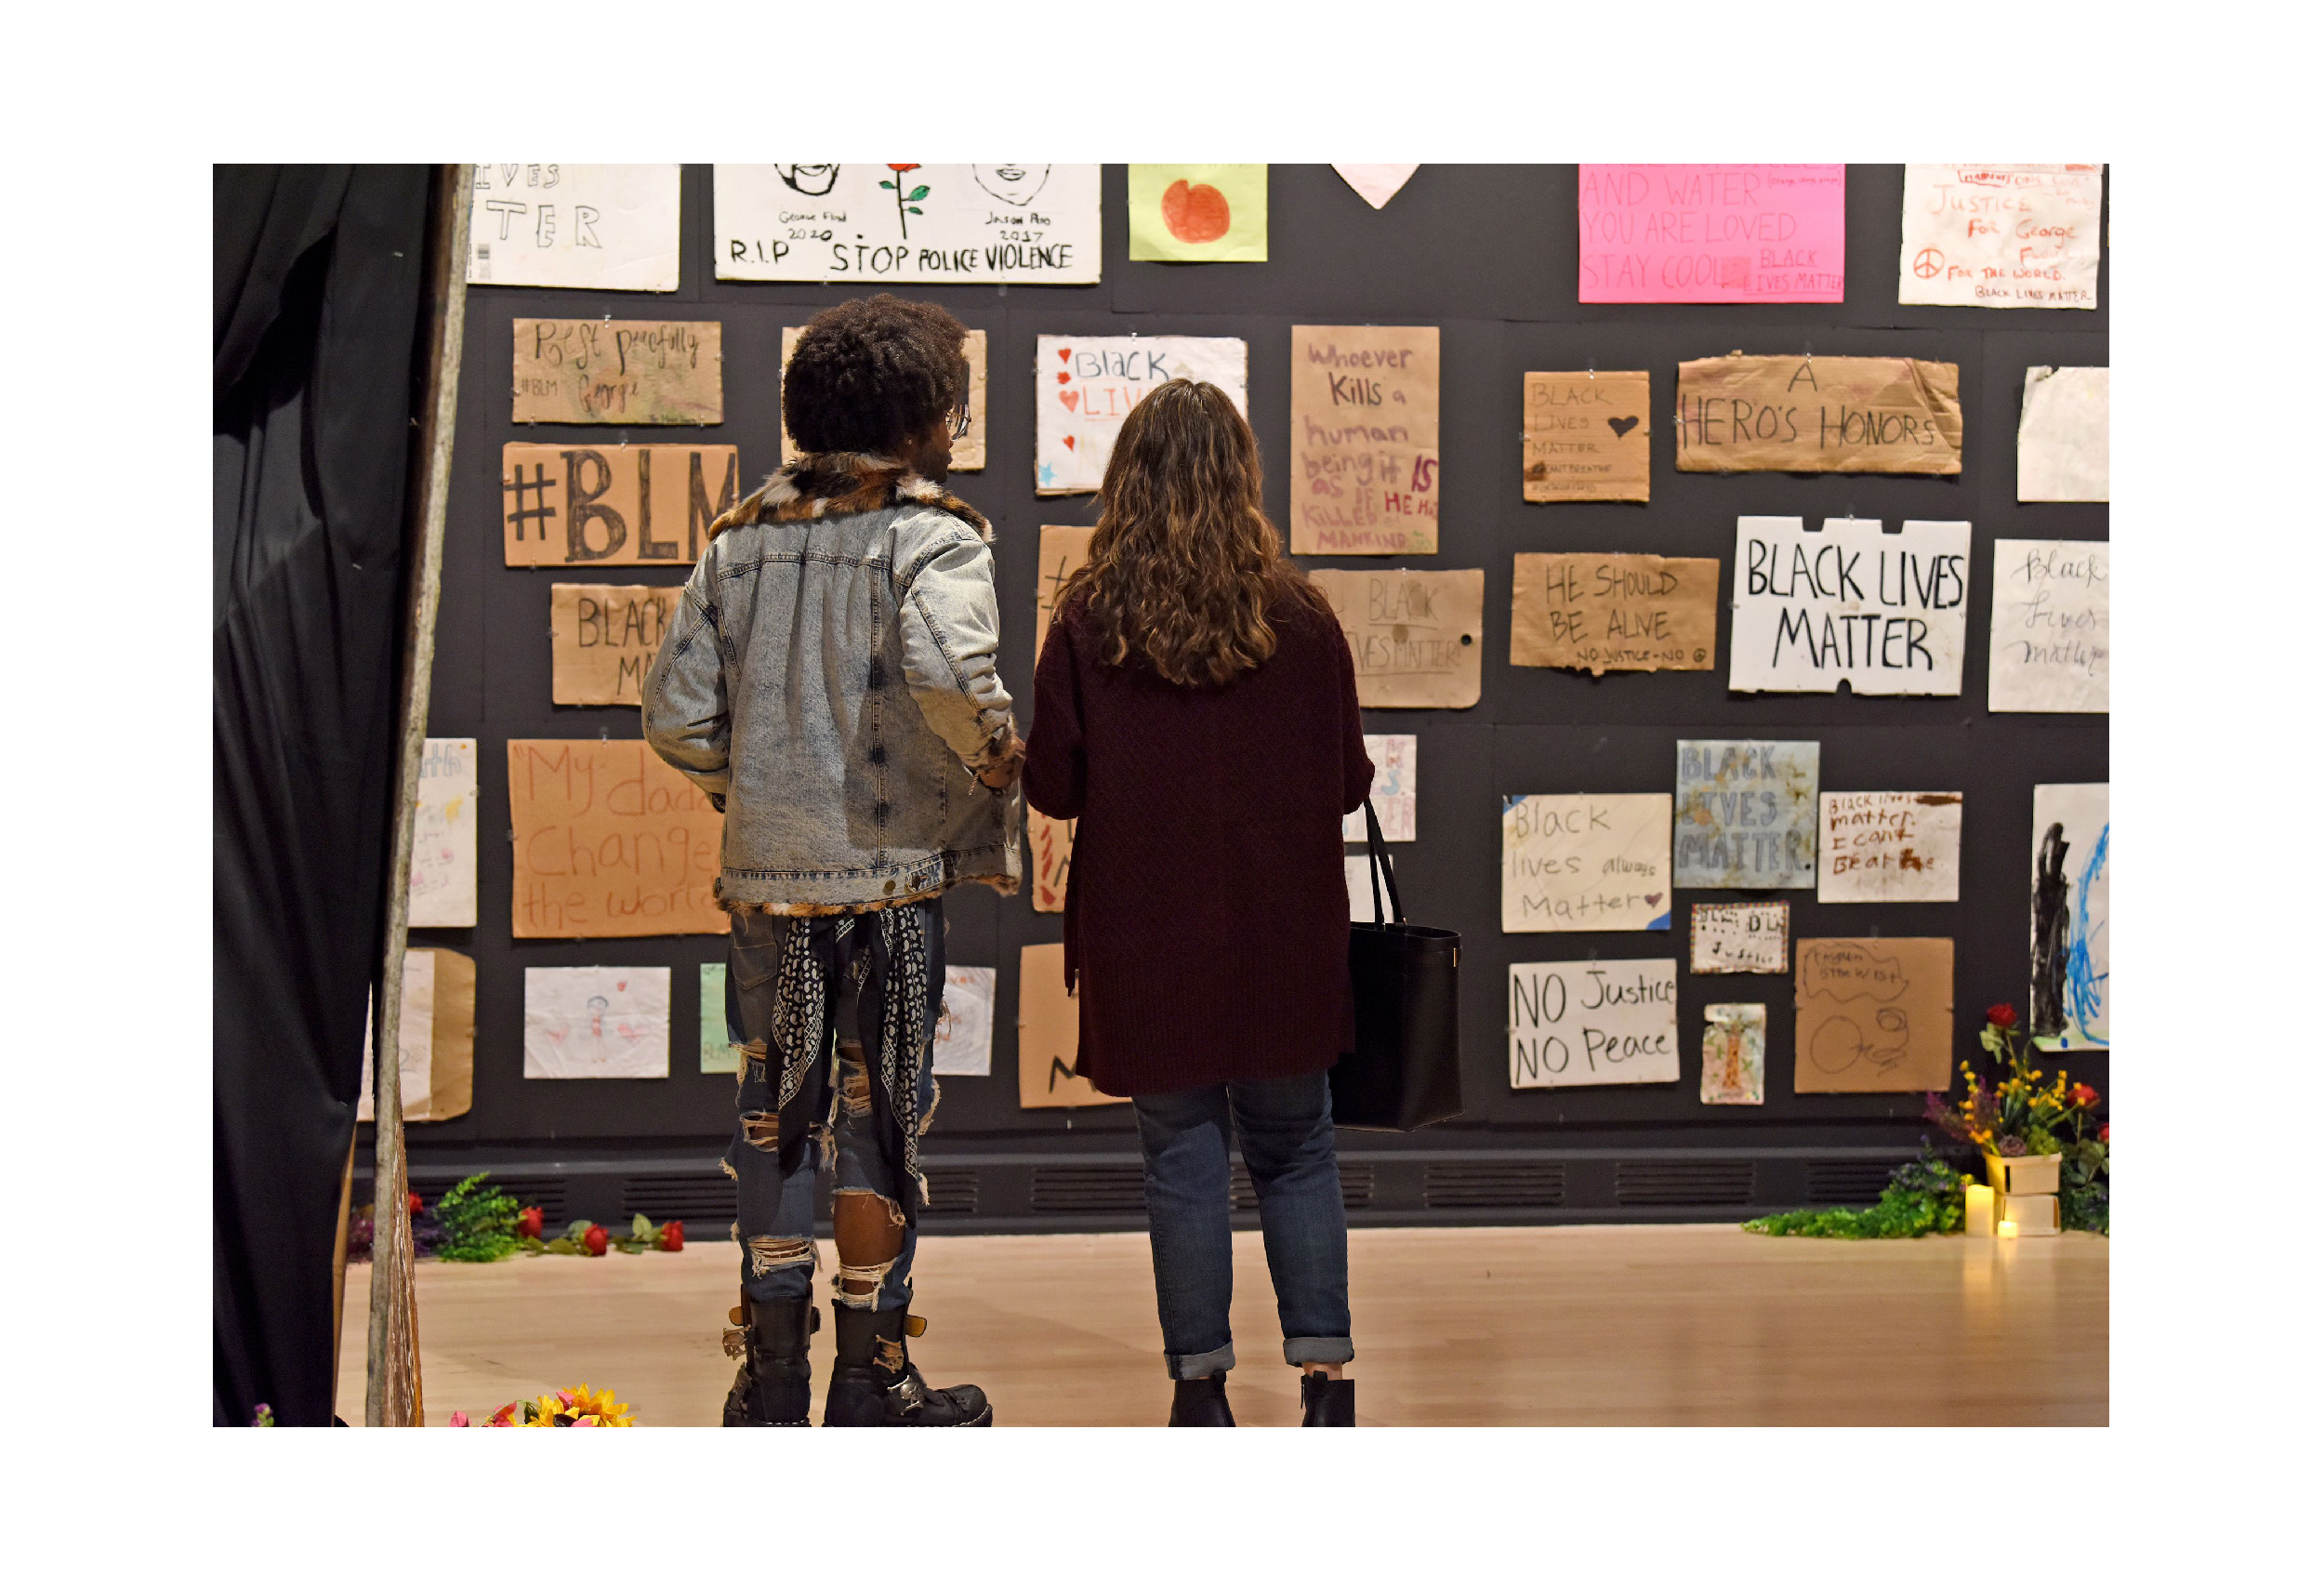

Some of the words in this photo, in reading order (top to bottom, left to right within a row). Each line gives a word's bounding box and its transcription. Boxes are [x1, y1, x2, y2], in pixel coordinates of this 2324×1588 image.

[475, 164, 560, 190] IVES
[1582, 171, 1649, 206] AND
[1664, 172, 1761, 206] WATER
[485, 200, 602, 249] TER
[787, 228, 833, 241] 2020
[999, 230, 1044, 243] 2017
[1583, 211, 1634, 244] YOU
[1644, 211, 1697, 244] ARE
[1706, 212, 1797, 244] LOVED
[2015, 218, 2080, 250] George
[829, 243, 909, 273] STOP
[918, 248, 979, 272] POLICE
[985, 244, 1074, 271] VIOLENCE
[1582, 254, 1650, 289] STAY
[1760, 247, 1818, 268] BLACK
[1743, 272, 1789, 292] LIVES
[1797, 271, 1843, 291] MATTER
[535, 322, 602, 370] Rest
[522, 377, 558, 397] #BLM
[1528, 382, 1615, 407] BLACK
[1787, 363, 1818, 393] A
[1082, 385, 1153, 416] LIV
[1303, 414, 1409, 447] human
[1532, 414, 1590, 431] LIVES
[1682, 392, 1798, 450] HERO'S
[1819, 404, 1937, 450] HONORS
[1531, 442, 1601, 457] MATTER
[1301, 450, 1373, 487] being
[1410, 453, 1439, 493] IS
[505, 448, 737, 563] #BLM
[1383, 489, 1414, 516] HE
[1316, 529, 1406, 551] MANKIND
[1546, 562, 1585, 604] HE
[1593, 563, 1679, 601] SHOULD
[1749, 538, 1865, 602] BLACK
[1880, 549, 1964, 610] LIVES
[2009, 548, 2108, 589] Black
[577, 597, 667, 648] BLACK
[1549, 610, 1589, 644] BE
[1606, 608, 1671, 642] ALIVE
[1772, 606, 1934, 671] MATTER
[1344, 631, 1391, 671] VES
[1577, 648, 1598, 663] NO
[1682, 745, 1776, 782] BLACK
[606, 747, 720, 817] dad
[1682, 790, 1777, 827] LIVES
[1678, 828, 1802, 873] MATTER
[1832, 837, 1846, 850] I
[1512, 850, 1581, 879] lives
[1602, 854, 1657, 878] always
[522, 882, 588, 931] the
[1522, 893, 1641, 921] Matter
[1513, 972, 1566, 1028] NO
[1581, 970, 1674, 1010] Justice
[1516, 1036, 1569, 1085] NO
[1582, 1026, 1670, 1072] Peace
